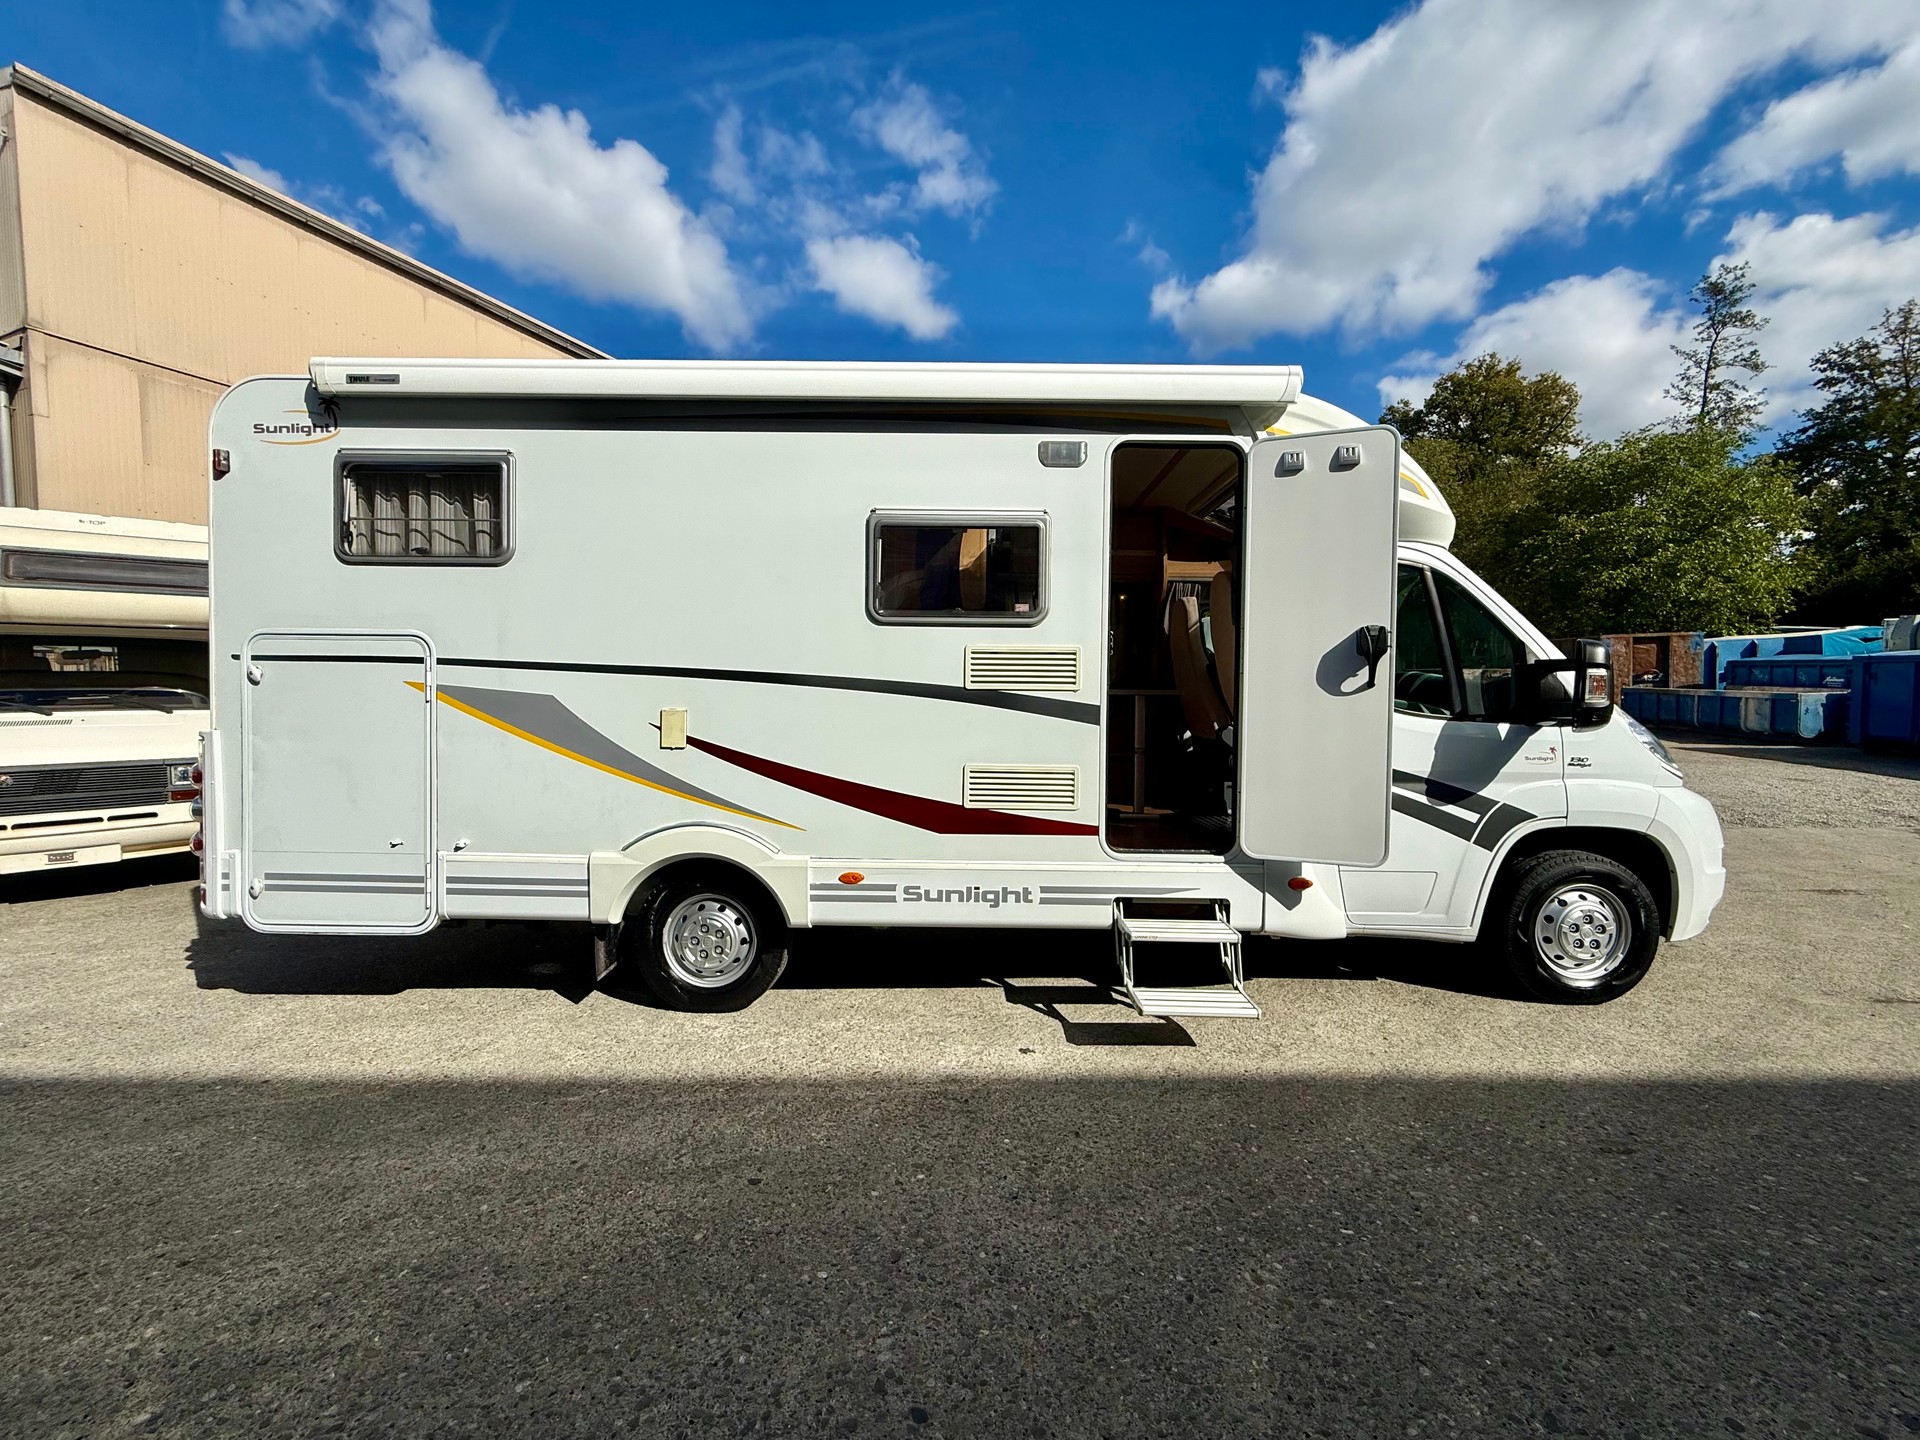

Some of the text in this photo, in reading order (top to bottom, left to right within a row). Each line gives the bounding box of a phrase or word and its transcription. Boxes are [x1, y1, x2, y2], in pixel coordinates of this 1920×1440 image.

[348, 375, 370, 383] THULE
[253, 423, 332, 437] Sunlight
[902, 885, 1034, 909] Sunlight
